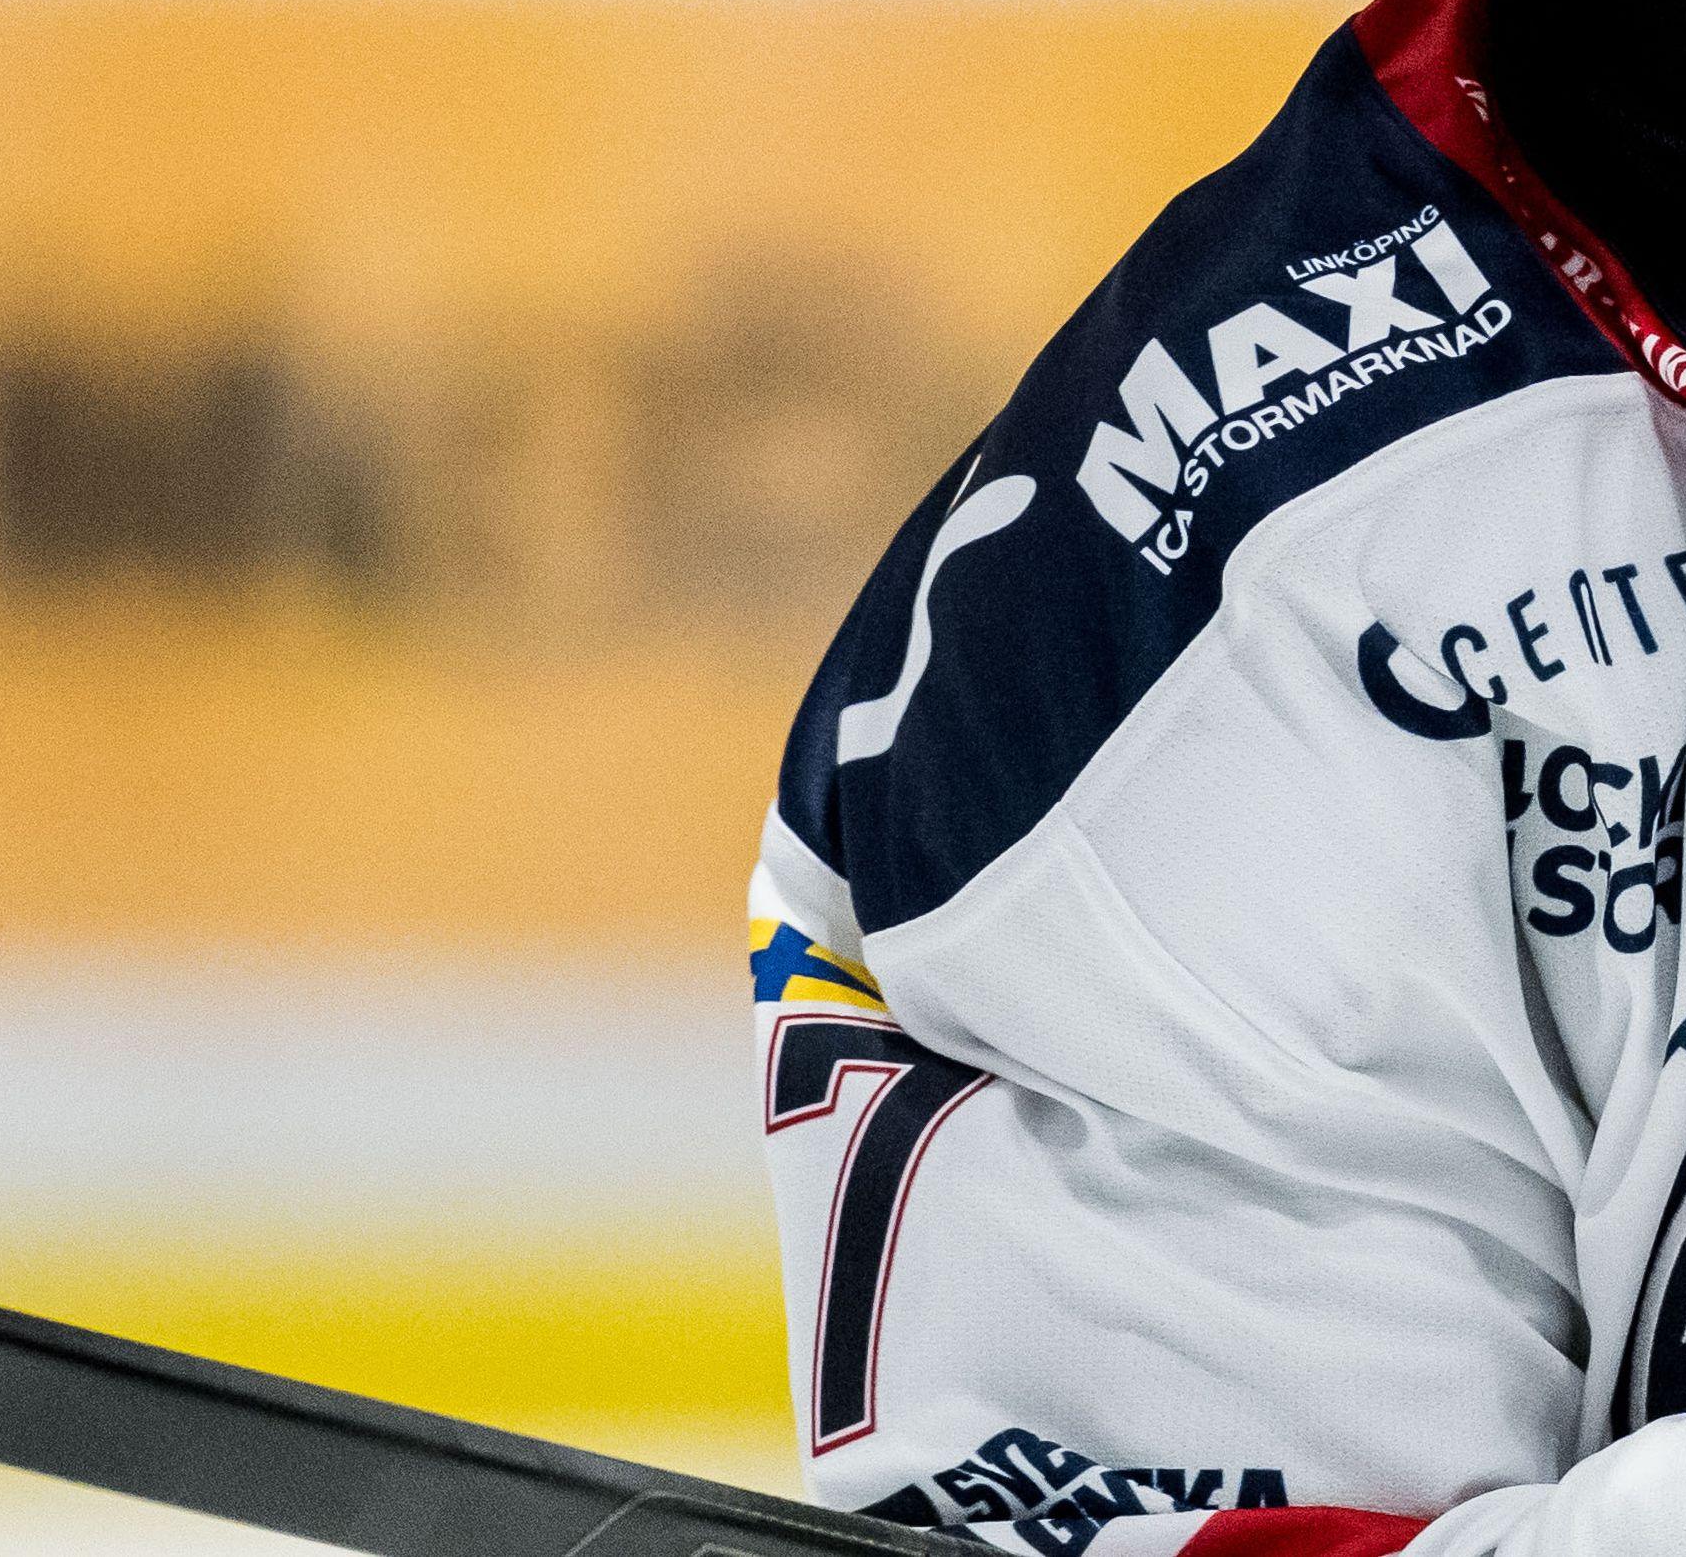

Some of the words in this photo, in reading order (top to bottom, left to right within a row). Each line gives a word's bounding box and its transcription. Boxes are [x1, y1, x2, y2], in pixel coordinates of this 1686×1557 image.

[1285, 203, 1440, 281] LINKÖPING
[1075, 218, 1492, 544] MAXI
[1183, 298, 1513, 497] STORMARKNAD
